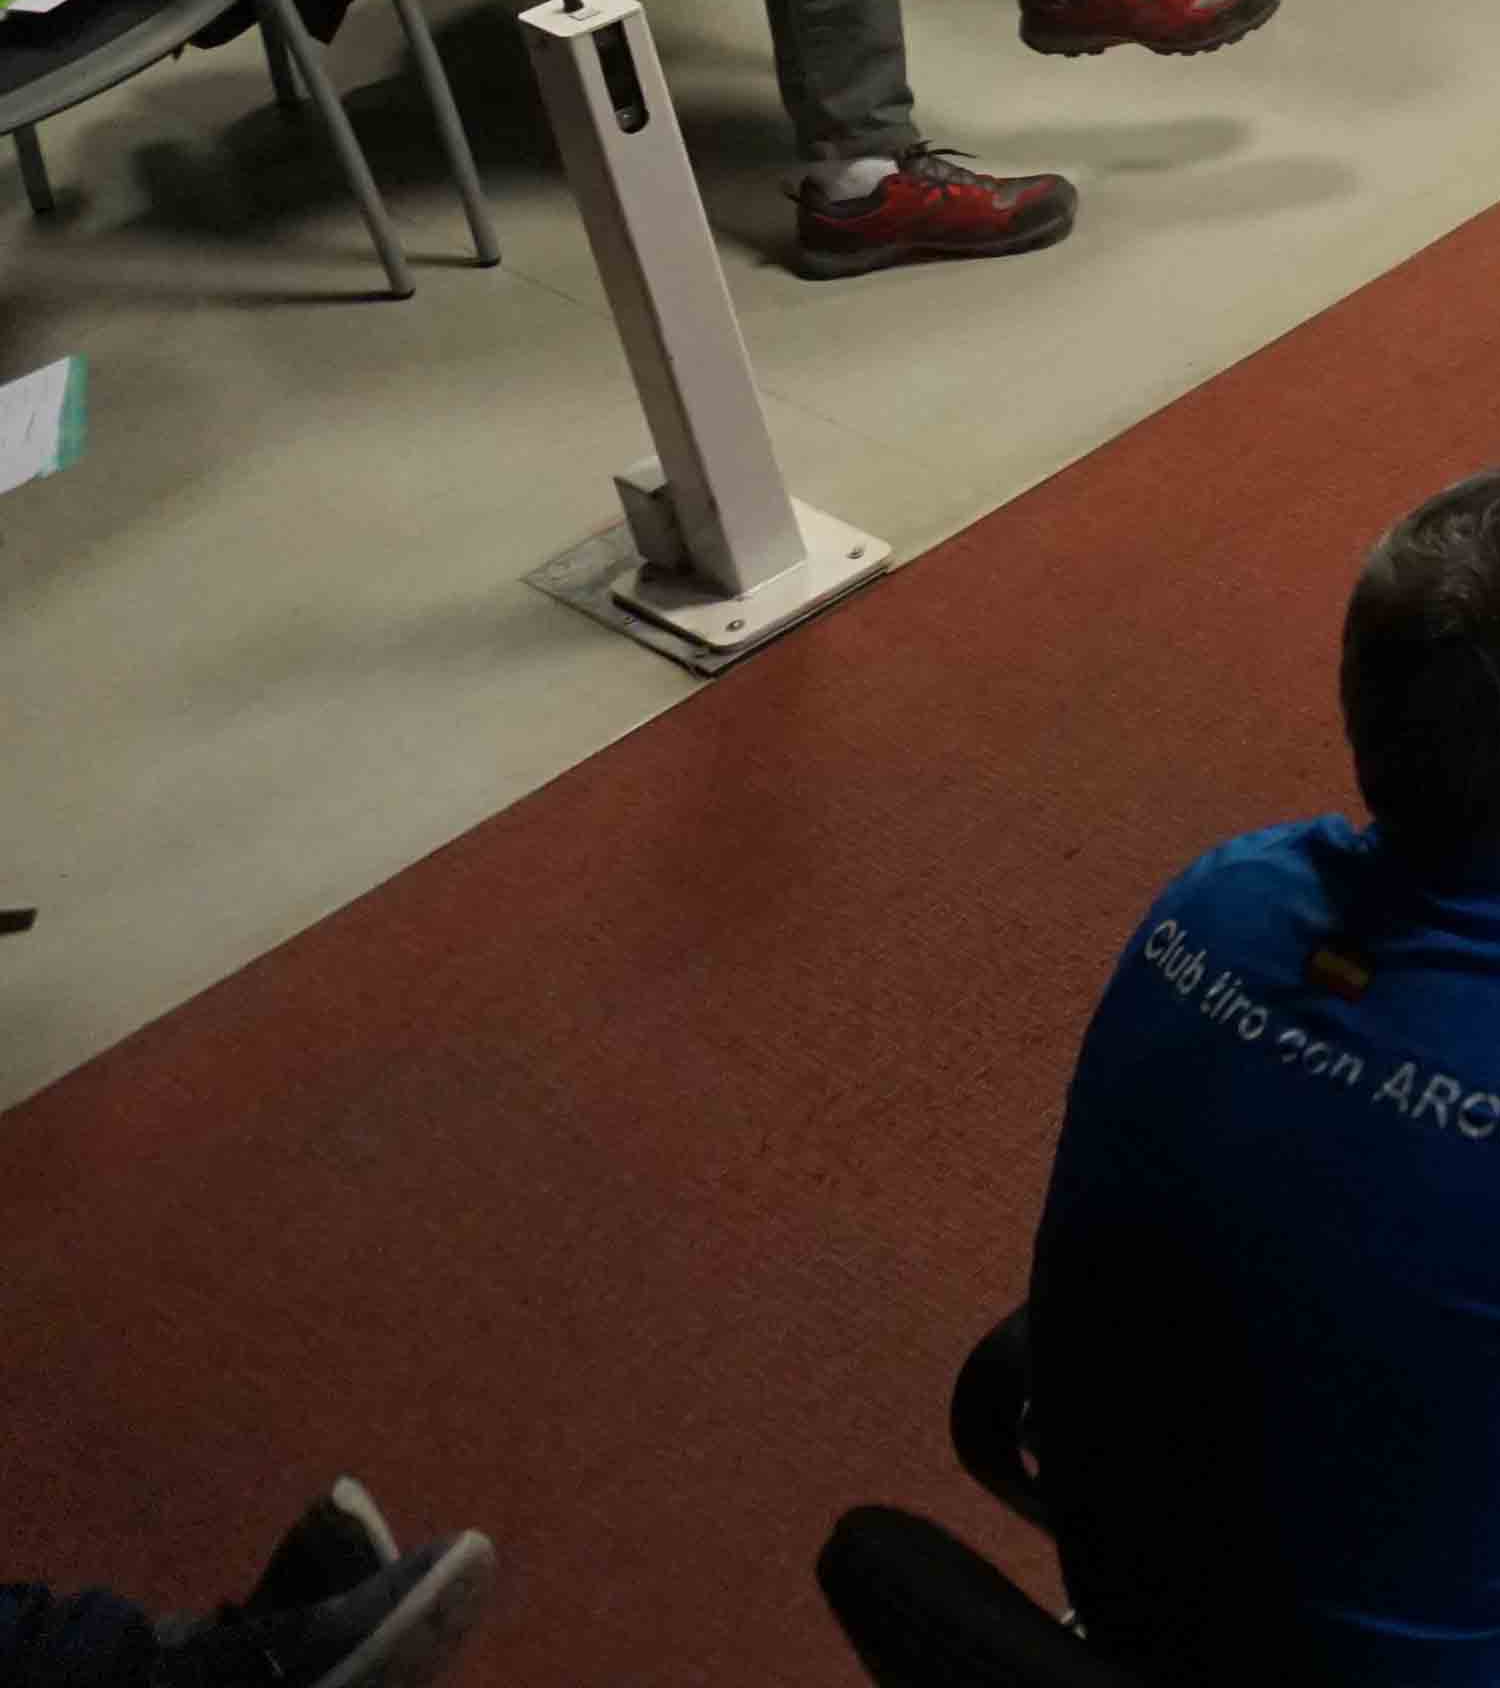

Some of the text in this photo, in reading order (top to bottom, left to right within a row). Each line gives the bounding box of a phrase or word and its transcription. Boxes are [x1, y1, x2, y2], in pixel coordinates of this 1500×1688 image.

[1143, 918, 1207, 996] Club
[1198, 969, 1270, 1041] tiro
[1276, 1027, 1366, 1086] con
